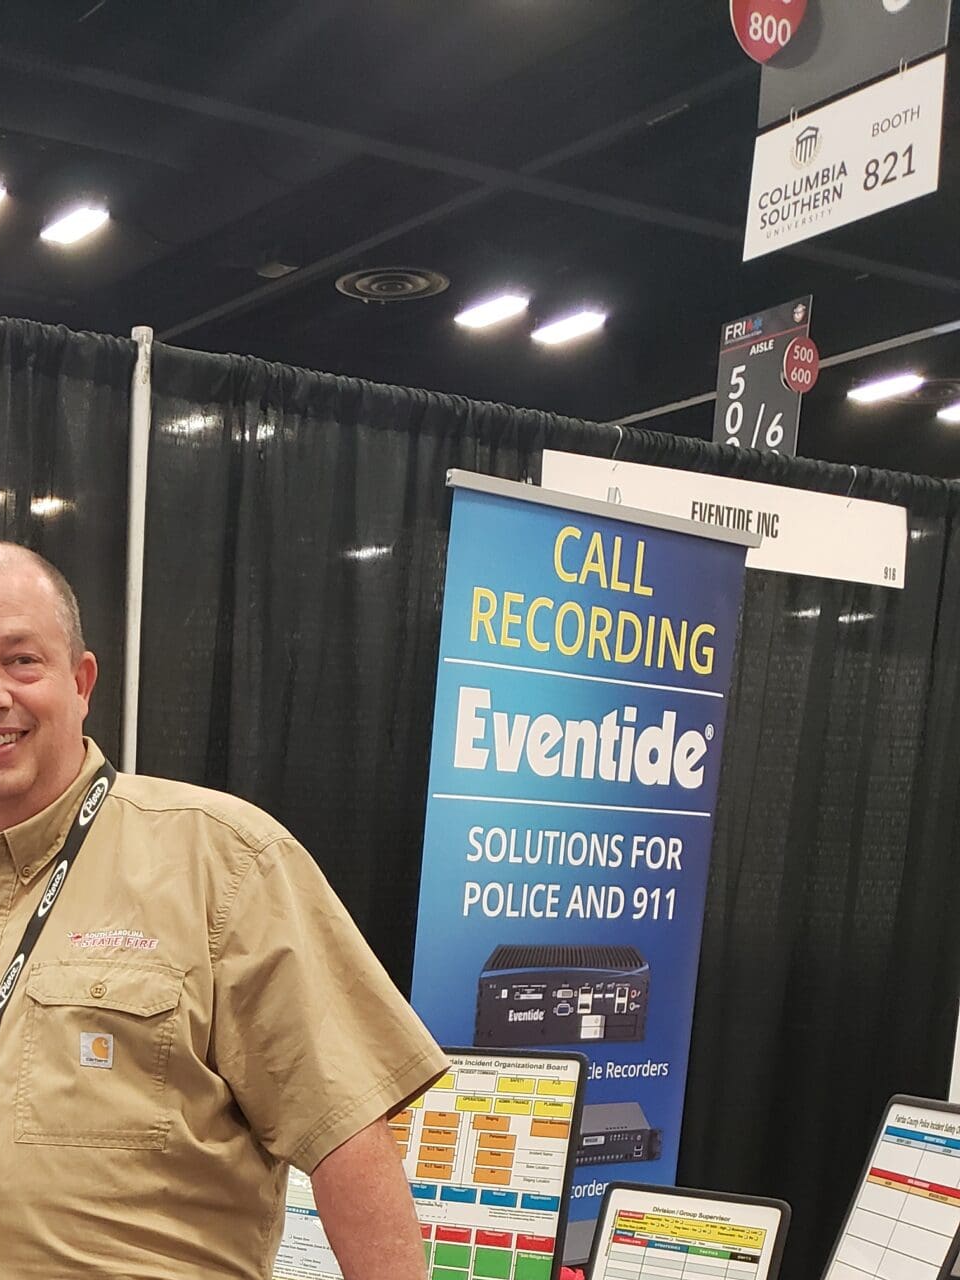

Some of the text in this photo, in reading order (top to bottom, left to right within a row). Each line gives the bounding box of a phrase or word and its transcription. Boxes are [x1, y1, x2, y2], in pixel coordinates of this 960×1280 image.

[748, 11, 791, 47] 800
[871, 105, 921, 138] BOOTH
[862, 143, 916, 192] 821
[757, 160, 848, 211] COLUMBIA
[759, 183, 843, 230] SOUTHERN
[766, 208, 833, 239] UNIVERSITY
[749, 339, 775, 356] AISLE
[793, 345, 814, 364] 500
[790, 367, 812, 385] 600
[756, 511, 780, 539] INC
[553, 525, 654, 597] CALL
[468, 585, 716, 676] RECORDING
[466, 825, 683, 871] SOLUTIONS FOR
[462, 881, 677, 921] POLICE AND 911
[81, 936, 159, 950] STATE FIRE
[494, 1061, 545, 1070] Organizational
[546, 1063, 569, 1071] Board
[606, 1059, 669, 1078] Recorders
[652, 1206, 675, 1216] Division
[679, 1209, 698, 1219] Group
[698, 1211, 732, 1222] Supervisor
